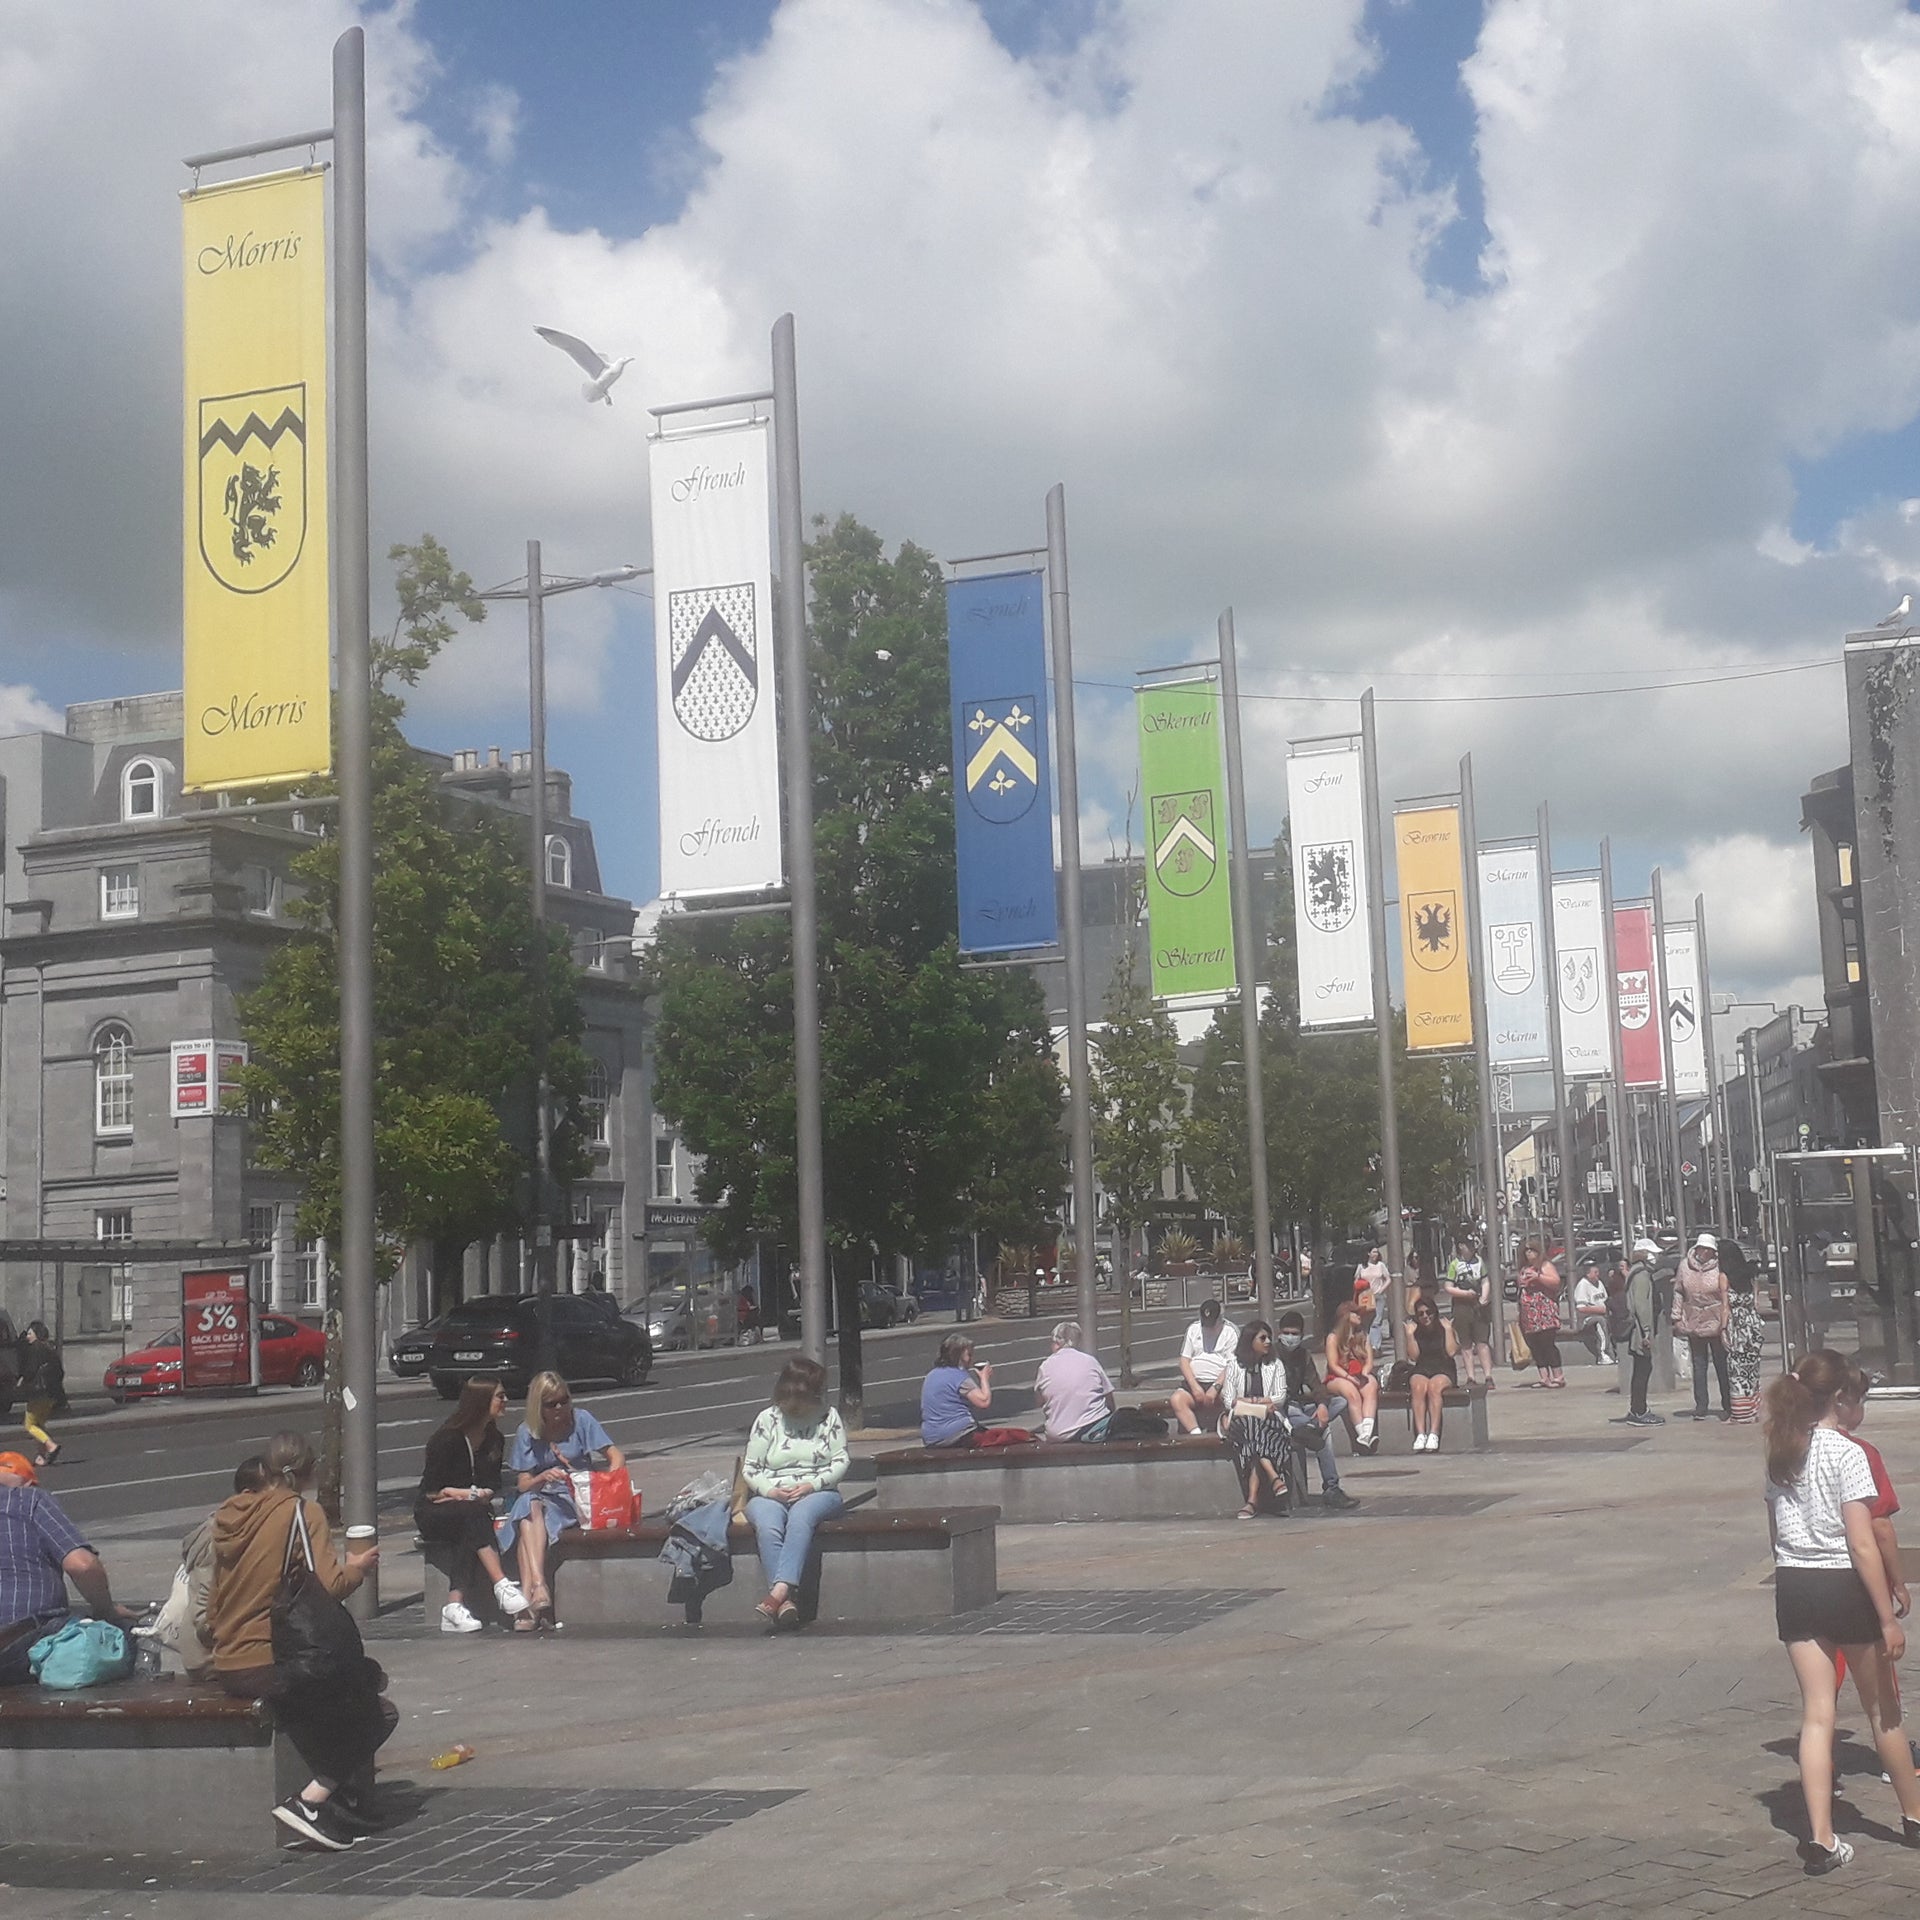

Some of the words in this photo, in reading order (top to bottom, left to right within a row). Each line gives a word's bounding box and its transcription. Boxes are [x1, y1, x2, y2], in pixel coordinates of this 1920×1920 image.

[198, 230, 302, 274] Morris
[671, 462, 745, 502] Ffrench
[201, 692, 307, 736] Morris
[1143, 711, 1211, 734] Skerrett
[1304, 770, 1343, 793] Font
[680, 815, 760, 856] Ffrench
[1402, 830, 1451, 846] Browne
[1487, 869, 1529, 883] Martin
[1157, 947, 1225, 969] Skerrett
[1315, 976, 1355, 999] Font
[1413, 1011, 1462, 1027] Browne
[1496, 1030, 1538, 1044] Martin
[650, 1214, 702, 1224] MCINERNE
[198, 1304, 237, 1331] 5%
